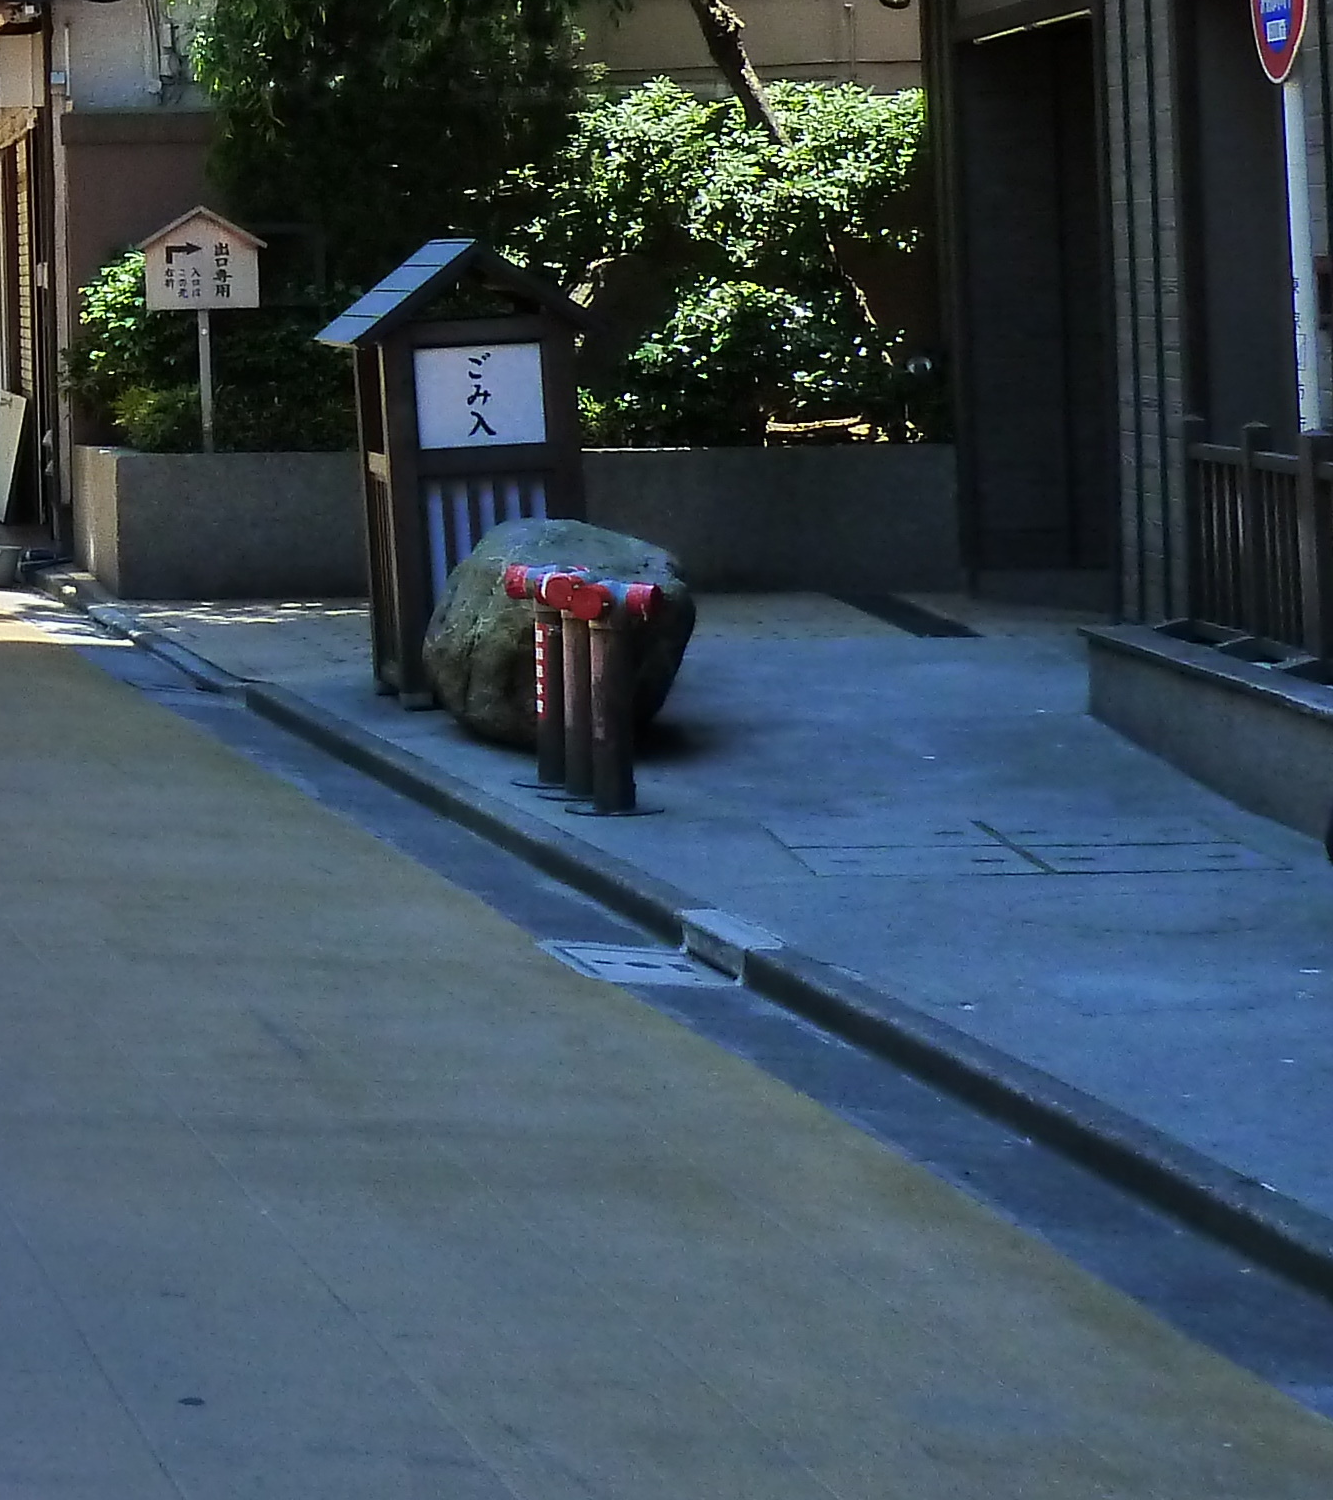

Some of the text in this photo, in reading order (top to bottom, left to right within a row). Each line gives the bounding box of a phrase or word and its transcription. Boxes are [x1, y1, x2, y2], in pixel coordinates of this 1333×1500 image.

[213, 242, 233, 298] 出口専用
[466, 352, 497, 437] ごみ入
